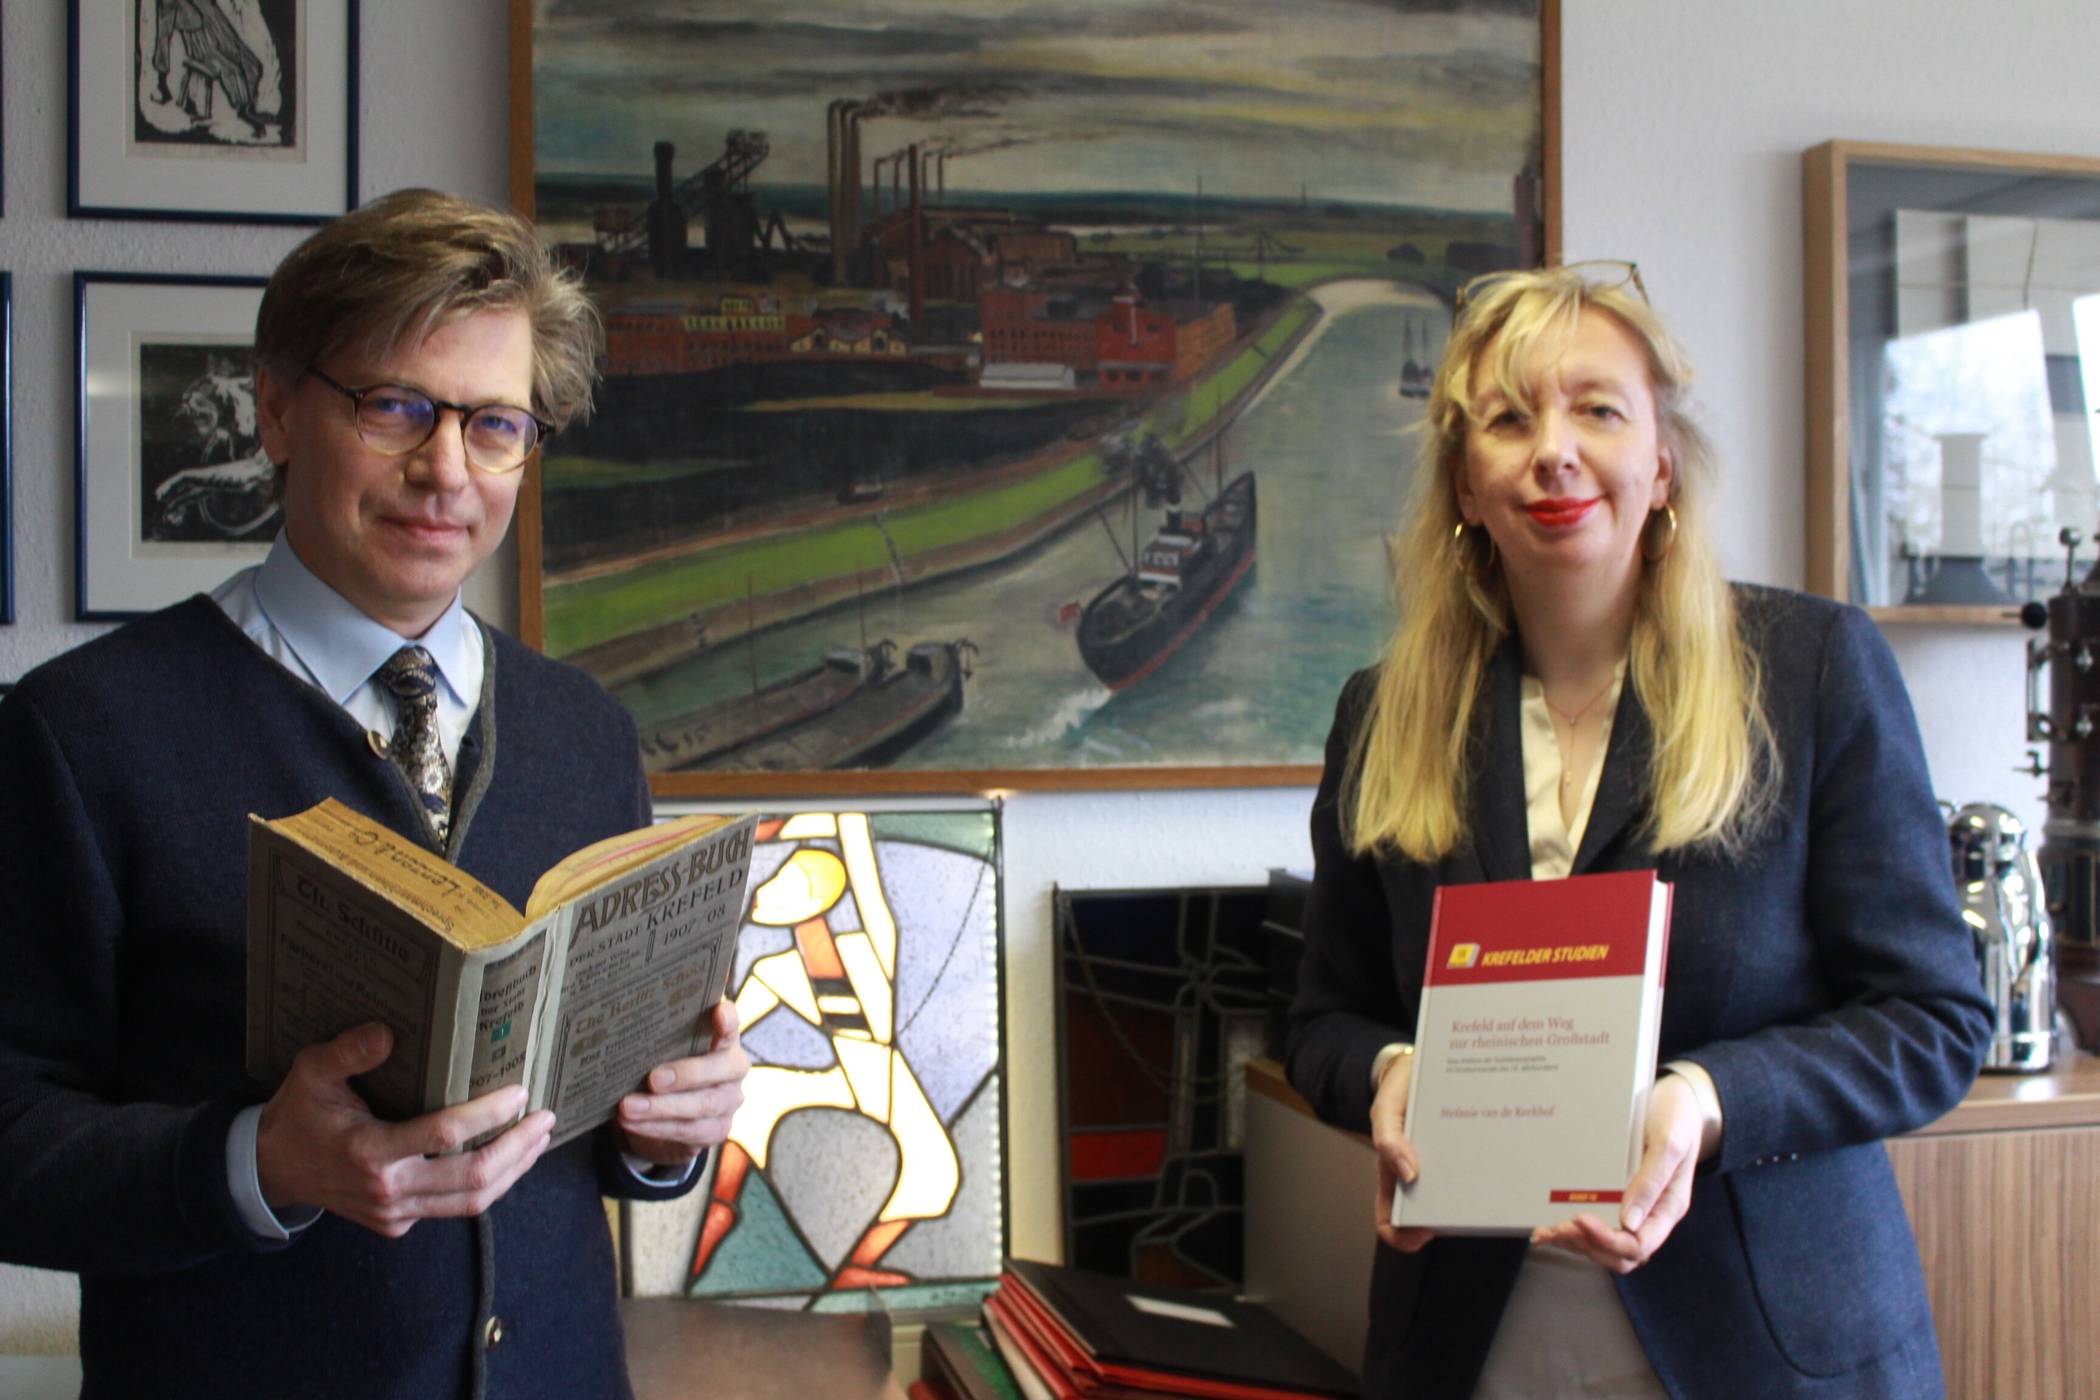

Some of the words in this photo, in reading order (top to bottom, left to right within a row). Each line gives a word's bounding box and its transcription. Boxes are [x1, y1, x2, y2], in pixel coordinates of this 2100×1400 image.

[568, 826, 750, 952] ADRESS-BUCH
[599, 926, 640, 951] STADT
[646, 869, 743, 930] KREFELD
[1481, 948, 1552, 967] KREFELDER
[1552, 944, 1610, 963] STUDIEN
[1452, 1018, 1494, 1033] Krefeld
[1496, 1018, 1516, 1032] auf
[1518, 1018, 1544, 1031] dem
[1547, 1017, 1574, 1032] Weg
[1472, 1034, 1543, 1049] rheinischen
[1546, 1031, 1610, 1047] Großstadt
